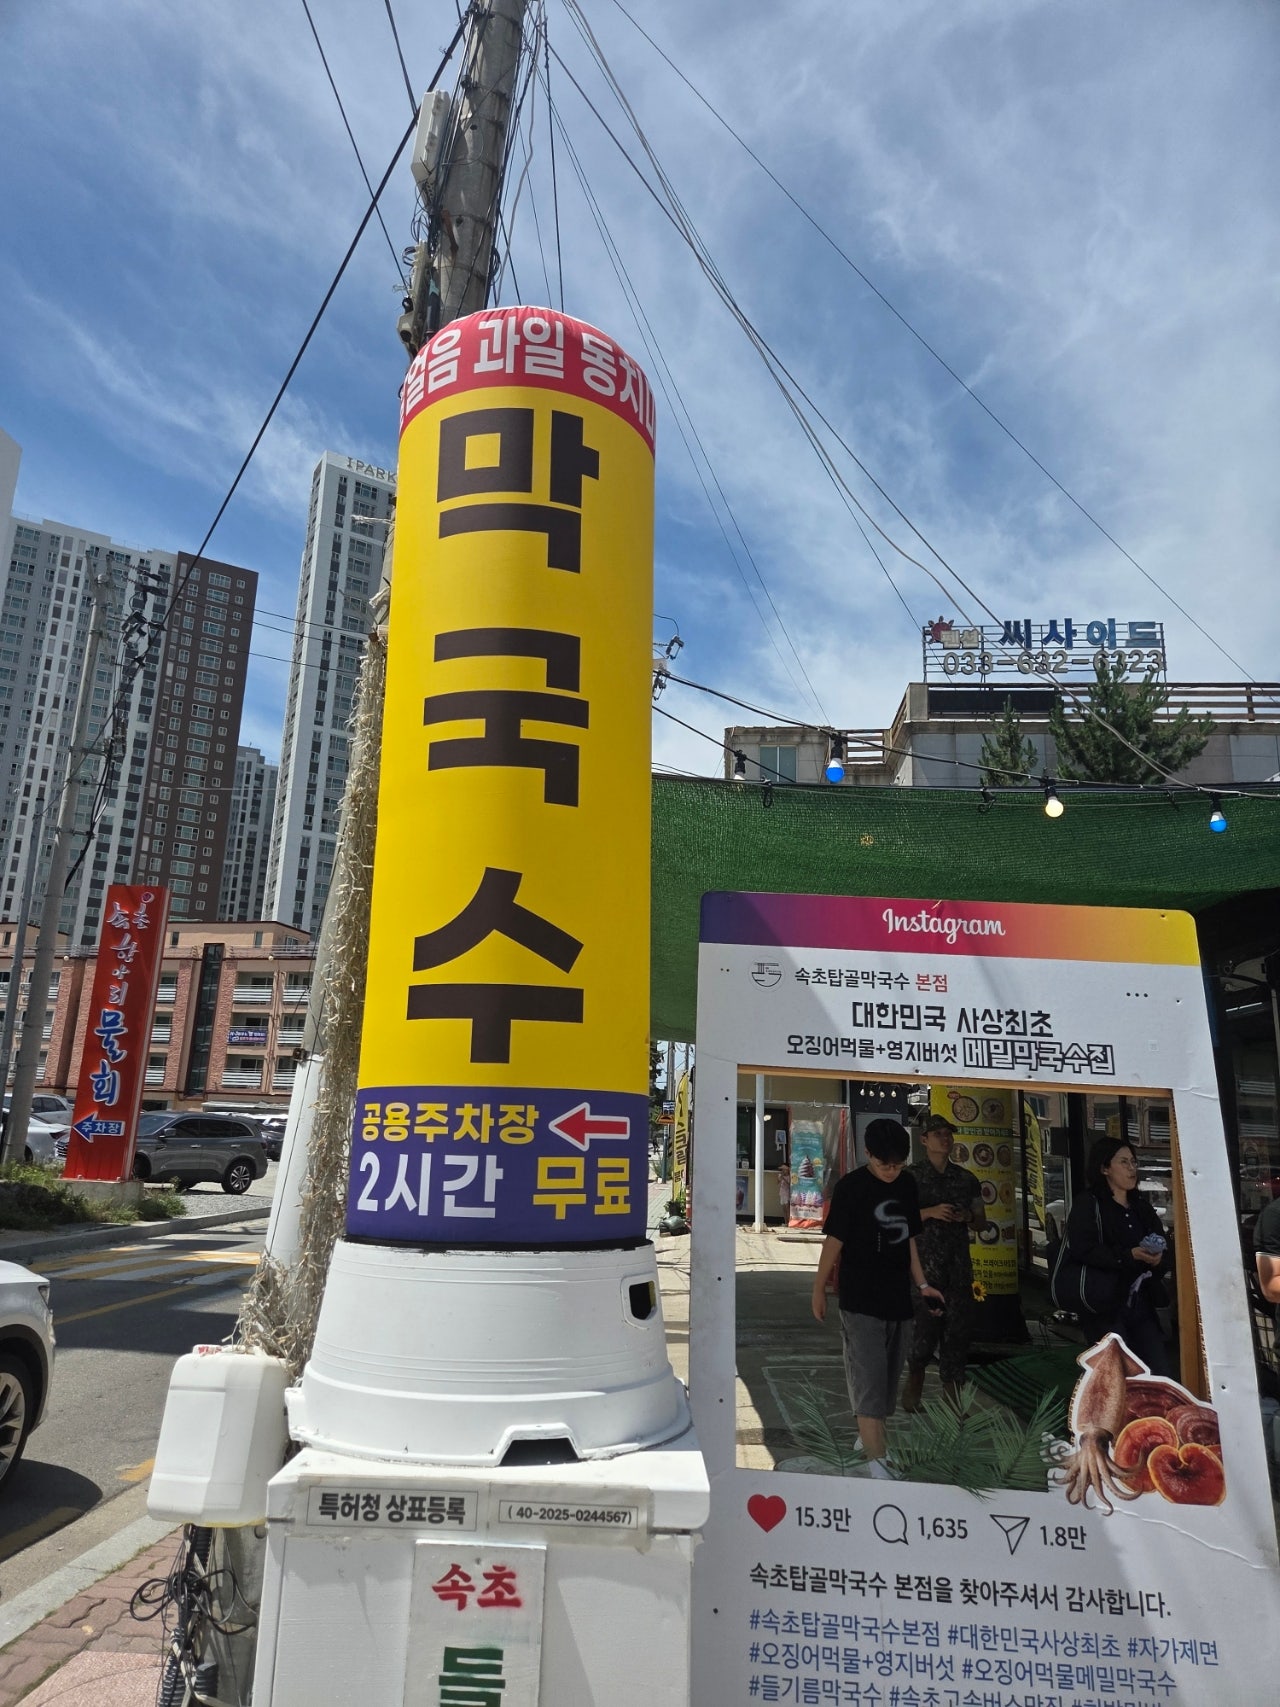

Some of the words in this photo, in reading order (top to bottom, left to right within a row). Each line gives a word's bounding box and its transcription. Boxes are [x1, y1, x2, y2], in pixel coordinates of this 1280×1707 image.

[399, 329, 462, 434] 얼음
[474, 316, 565, 379] 과일
[346, 456, 397, 484] IPARK
[999, 617, 1161, 650] 씨사이드
[406, 408, 600, 1064] 막국수
[107, 891, 153, 931] 속초
[882, 908, 1006, 945] Instagram
[794, 967, 910, 991] 속초탑골막국수
[915, 972, 949, 993] 본점
[852, 1001, 947, 1032] 대한민국
[957, 1007, 1054, 1038] 사상최초
[90, 1009, 127, 1107] 물회
[786, 1034, 957, 1064] 오징어먹물+영지버섯
[963, 1037, 1116, 1076] 메밀막국수집
[81, 1120, 121, 1135] 주차장
[361, 1102, 540, 1145] 공용주차장
[357, 1151, 503, 1219] 2시간
[532, 1156, 632, 1220] 무료
[319, 1493, 381, 1522] 특허청
[386, 1495, 466, 1525] 상표등록
[795, 1506, 851, 1532] 15.3만
[917, 1516, 968, 1540] 1,635
[1040, 1525, 1087, 1550] 1.8만
[432, 1564, 522, 1611] 속초
[750, 1562, 887, 1598] 속초탑골막국수
[894, 1574, 953, 1604] 본점을
[959, 1578, 1059, 1611] 찾아주셔서
[1065, 1586, 1171, 1618] 감사합니다.
[750, 1608, 940, 1648] #속초탑골막국수본점
[947, 1623, 1121, 1659] #대한민국사상최초
[1127, 1637, 1219, 1666] #자가제면
[749, 1642, 955, 1682] #오징어먹물+영지버섯
[962, 1657, 1177, 1696] #오징어먹물메밀막국수
[749, 1675, 882, 1705] #들기름막국수
